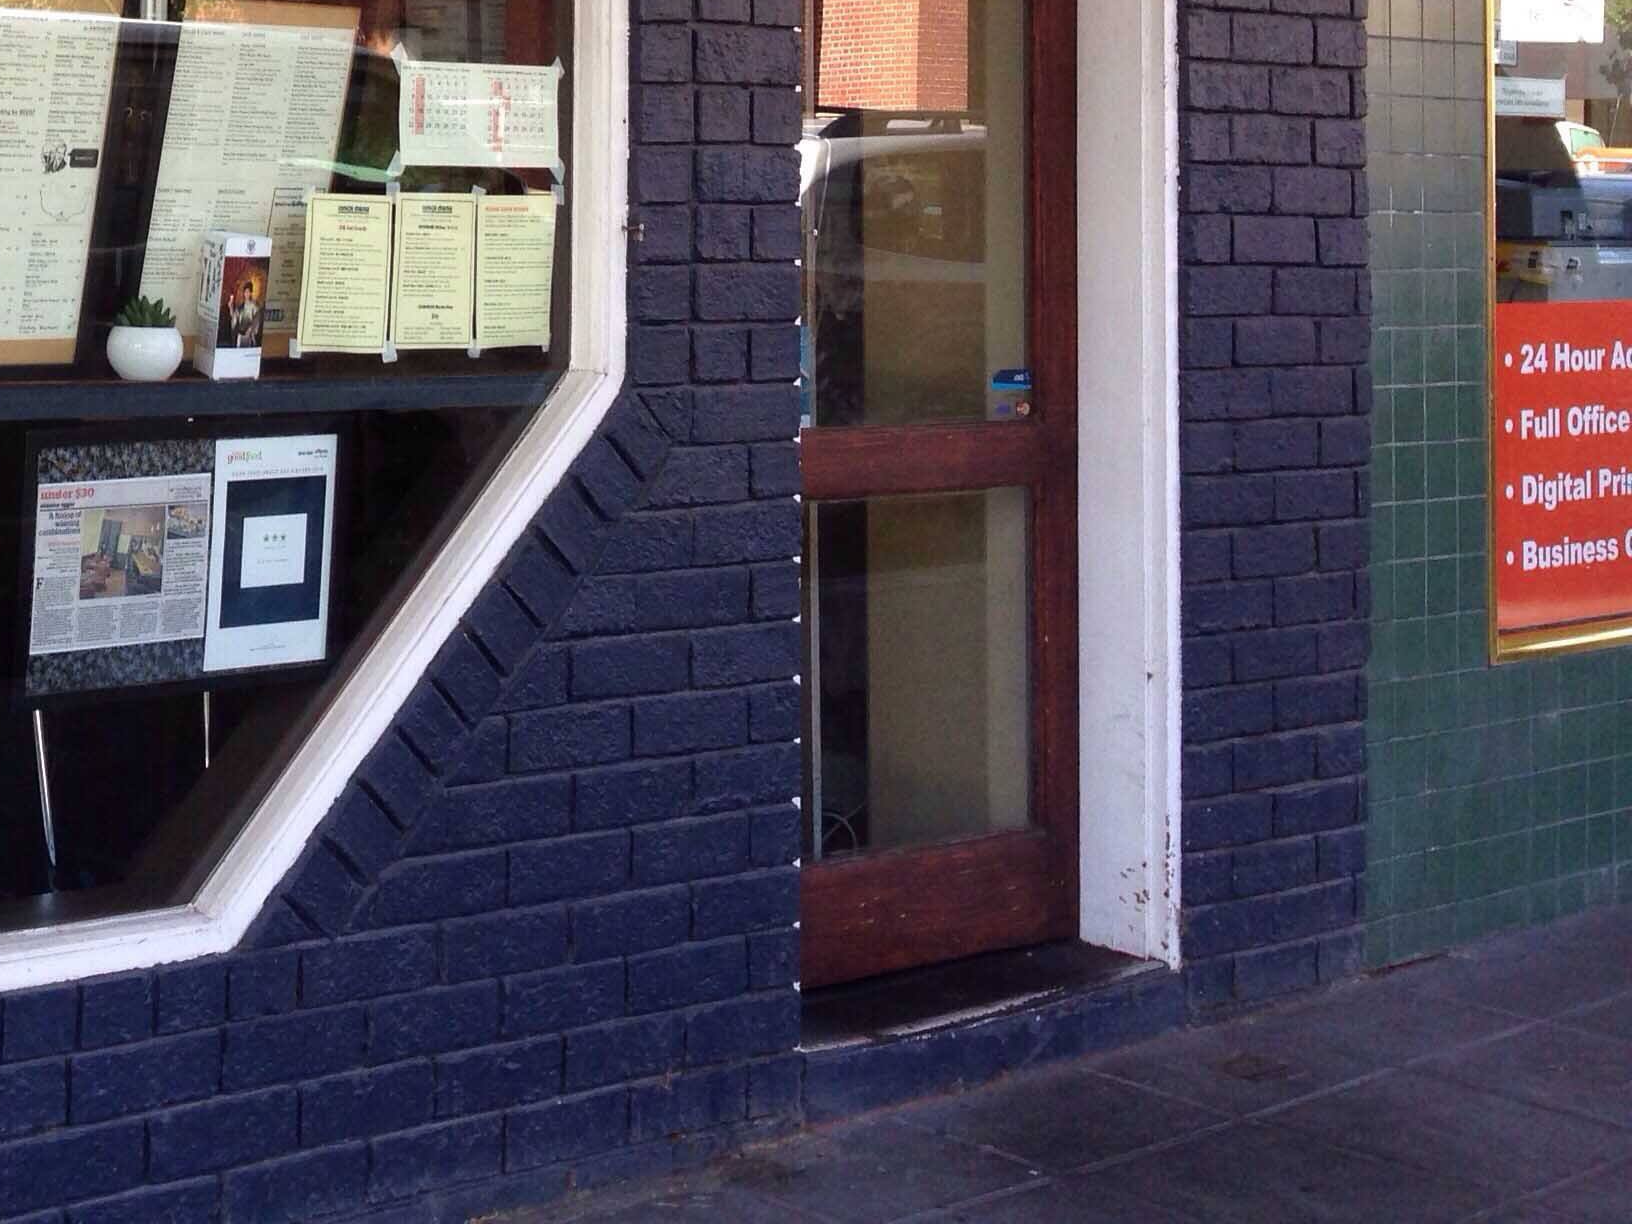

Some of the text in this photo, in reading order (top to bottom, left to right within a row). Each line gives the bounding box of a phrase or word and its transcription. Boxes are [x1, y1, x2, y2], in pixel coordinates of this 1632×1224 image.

[1520, 343, 1548, 374] 24
[1554, 342, 1606, 373] Hour
[1520, 404, 1631, 440] Full Office
[41, 487, 95, 500] under $30
[1522, 469, 1592, 511] Digital
[1522, 536, 1619, 572] Business
